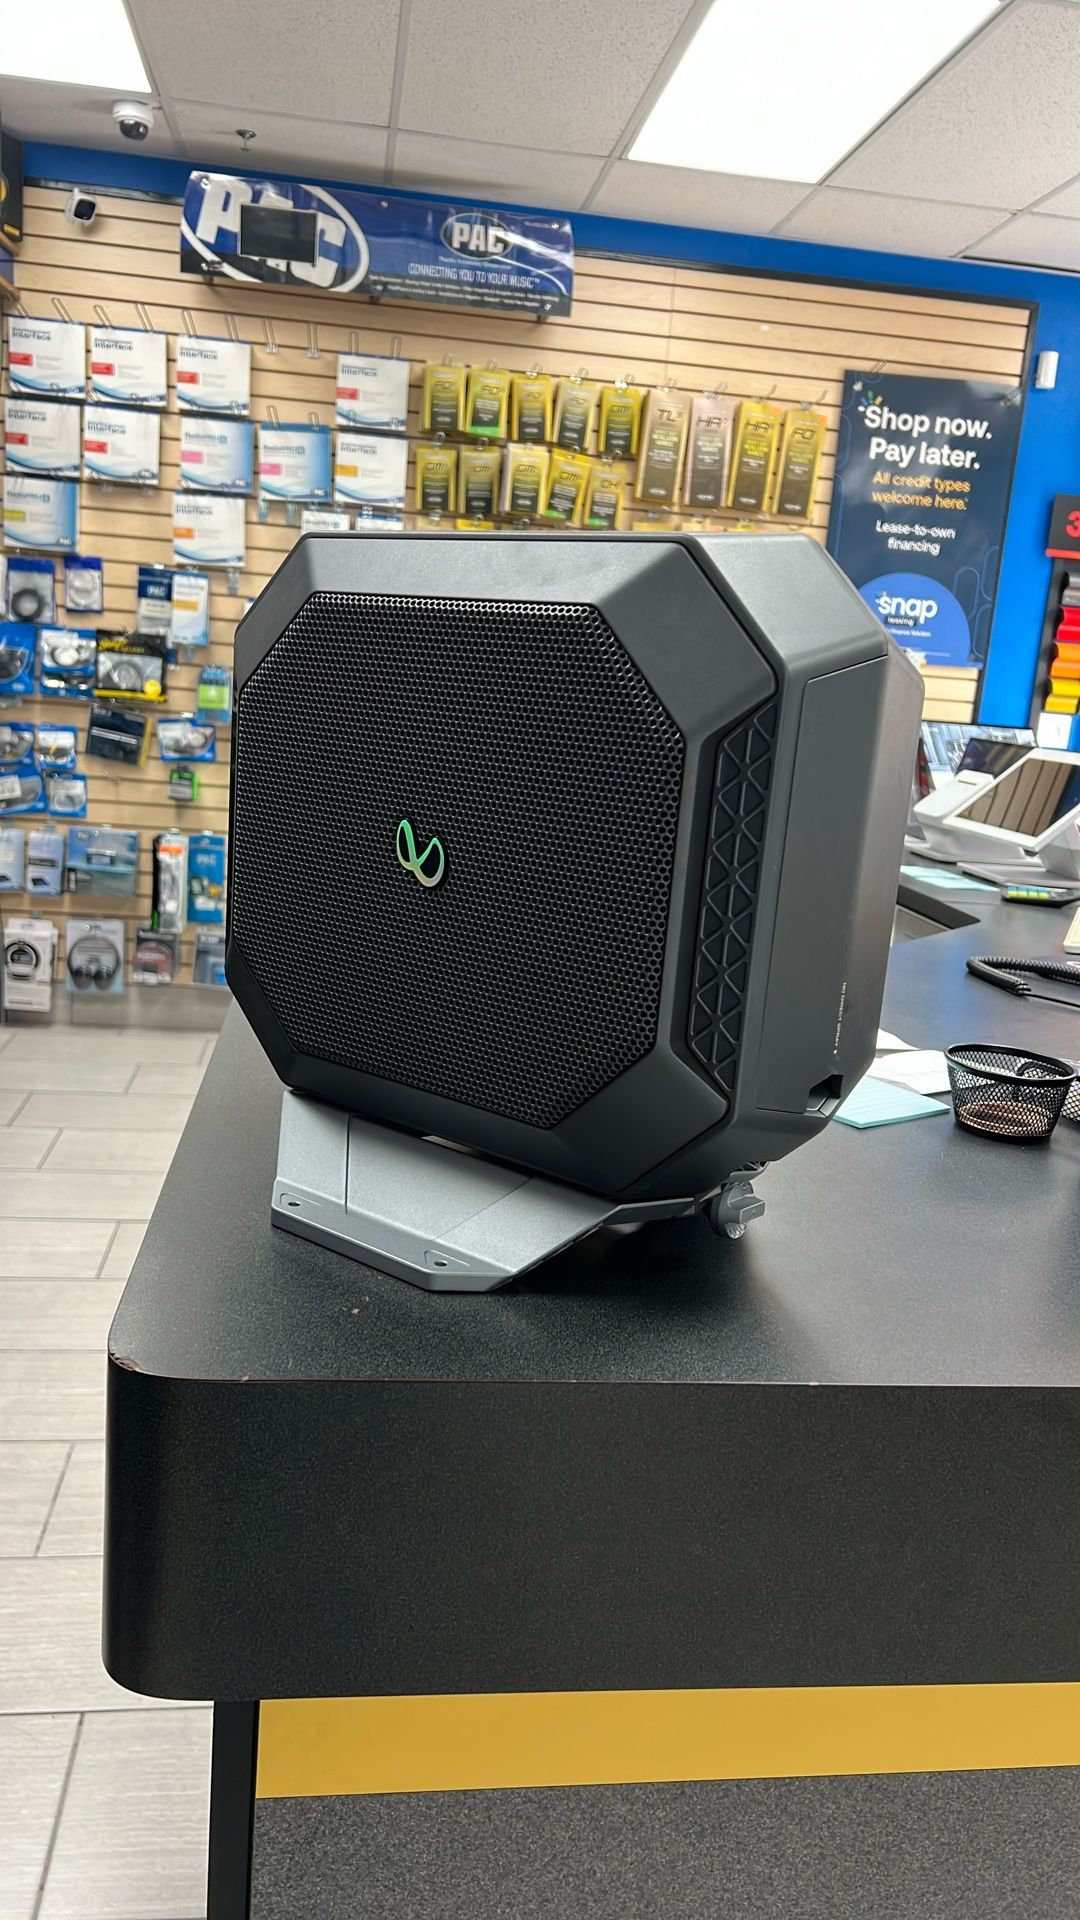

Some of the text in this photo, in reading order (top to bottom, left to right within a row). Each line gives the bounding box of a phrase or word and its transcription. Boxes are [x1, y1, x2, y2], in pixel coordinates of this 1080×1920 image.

[196, 178, 347, 288] PC
[452, 222, 506, 254] PAC
[863, 405, 993, 440] Shop now.
[868, 436, 981, 470] Pay later.
[872, 471, 972, 494] All credit types
[871, 491, 933, 507] welcome
[875, 519, 956, 539] Lease-to-own
[887, 536, 941, 556] financing
[877, 595, 938, 624] snap
